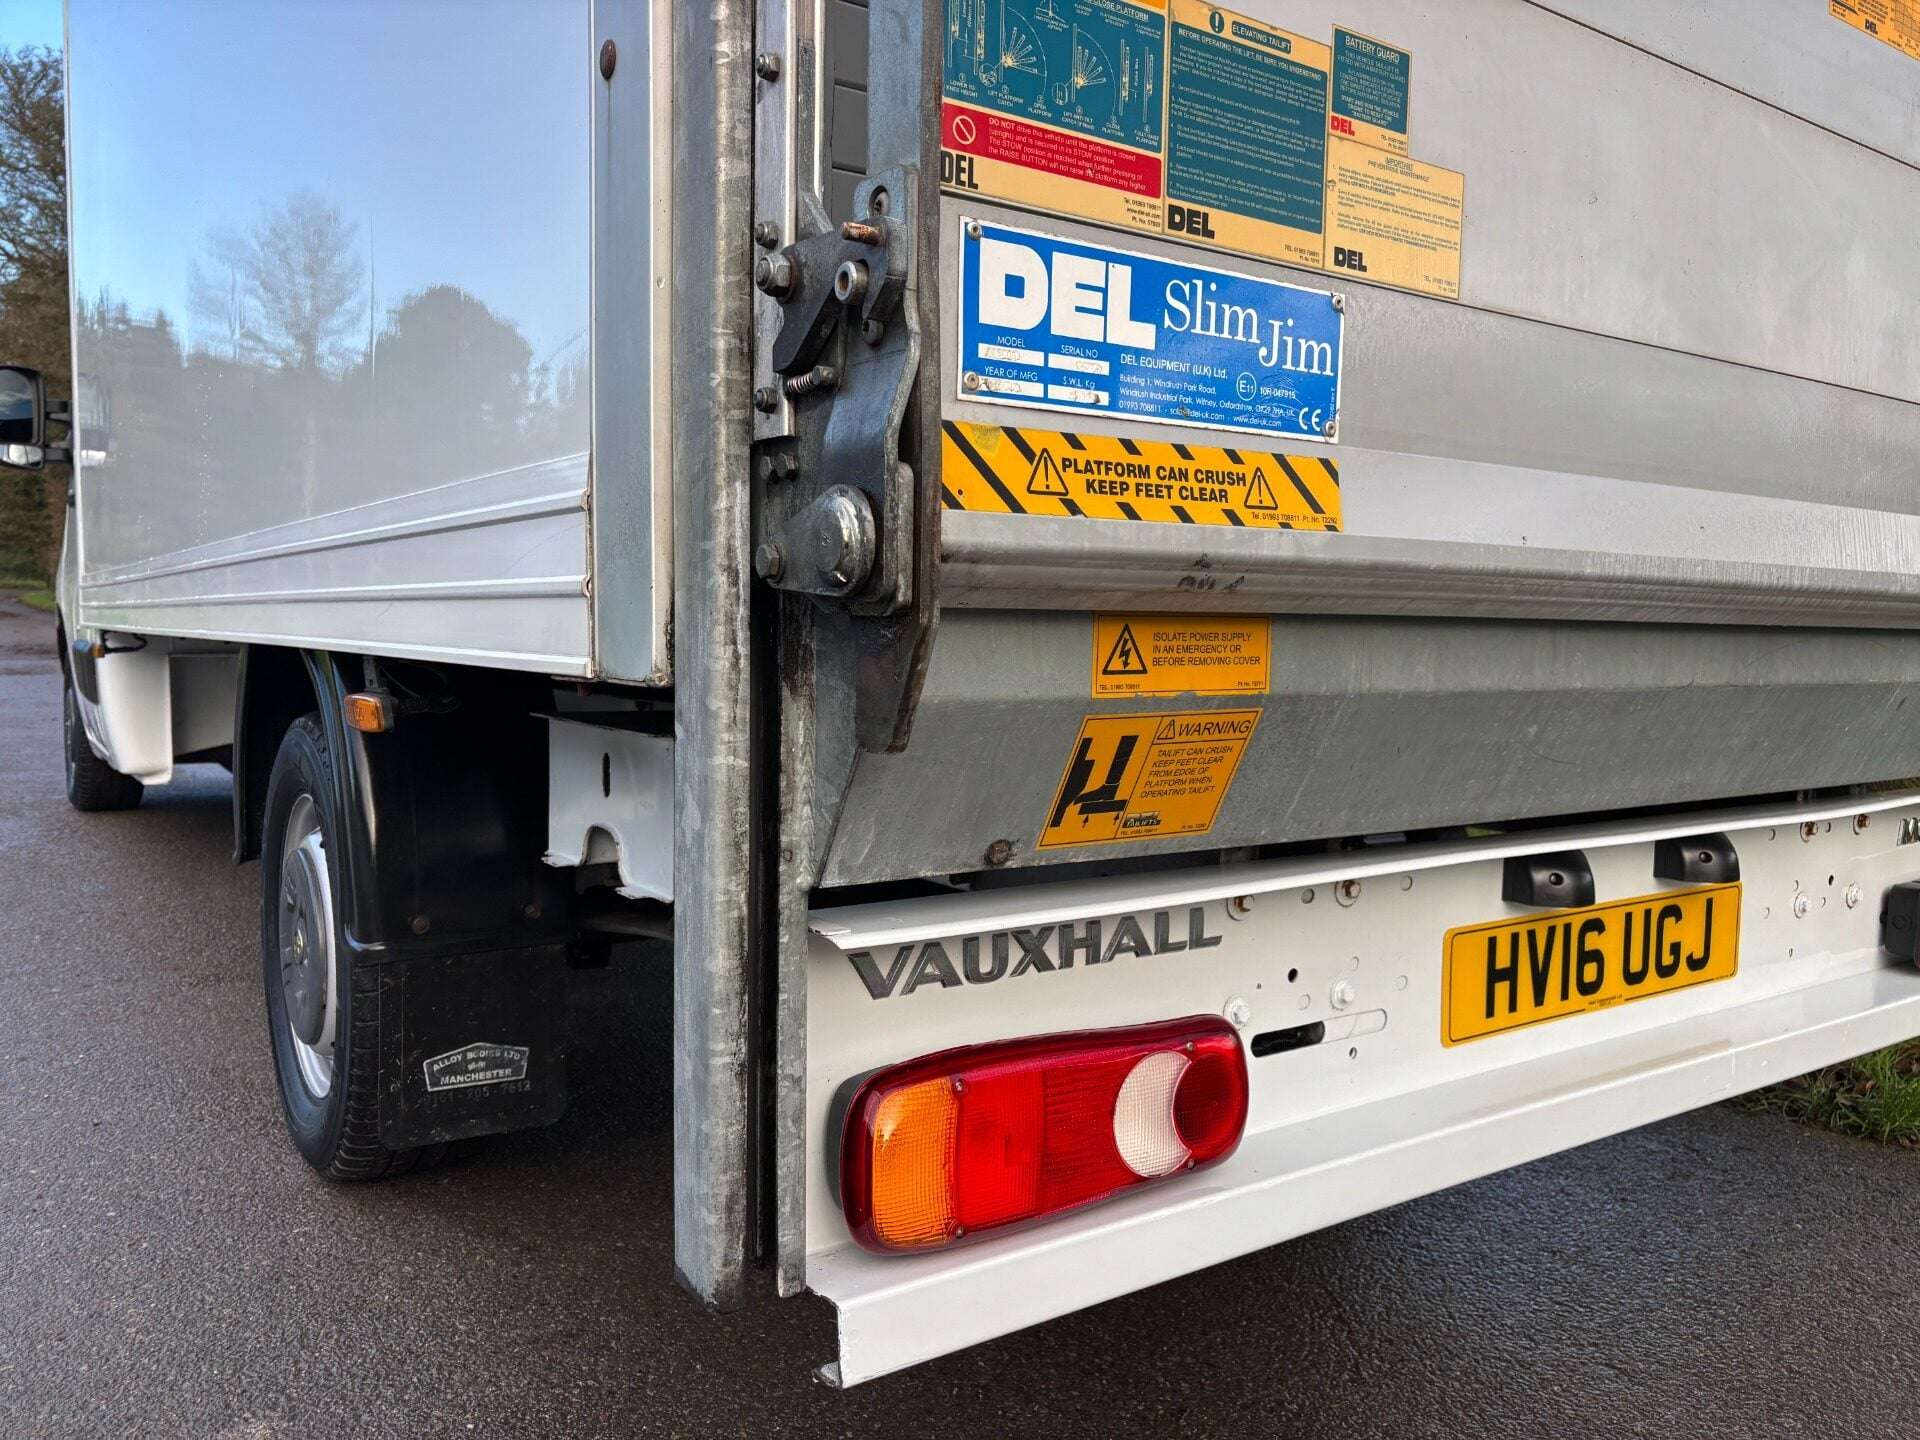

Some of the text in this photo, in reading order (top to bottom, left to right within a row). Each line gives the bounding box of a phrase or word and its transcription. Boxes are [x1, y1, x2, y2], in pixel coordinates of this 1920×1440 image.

[1116, 4, 1149, 21] PLATFORM
[1232, 24, 1268, 43] ELEVATING
[1178, 27, 1200, 40] BEFORE
[1201, 35, 1233, 51] OPERATING
[1264, 56, 1278, 66] SURE
[1278, 62, 1289, 70] YOU
[1289, 64, 1322, 81] UNDERSTAND
[1345, 35, 1400, 64] BATTERY GUARD
[950, 80, 968, 89] LOWER
[999, 92, 1024, 104] PLATFORM
[1034, 102, 1046, 110] OPEN
[1028, 107, 1052, 118] PLATFORM
[1102, 127, 1125, 137] PLATFORM
[1331, 115, 1355, 136] DEL
[988, 117, 1000, 127] DO
[1001, 120, 1015, 130] NOT
[1016, 125, 1031, 135] drive
[1032, 128, 1043, 138] this
[1044, 133, 1065, 143] vehicle
[1065, 137, 1077, 145] until
[1078, 141, 1088, 149] the
[1088, 143, 1112, 155] platform
[1118, 152, 1136, 162] closed
[1015, 134, 1027, 143] and
[1034, 139, 1058, 150] secured
[1073, 148, 1092, 159] STOW
[1136, 136, 1158, 146] PLATFORM
[989, 136, 1001, 145] The
[1002, 140, 1023, 151] STOW
[1023, 146, 1046, 158] position
[1053, 153, 1077, 165] reached
[1077, 160, 1093, 168] when
[1094, 162, 1112, 174] further
[1112, 168, 1136, 181] pressing
[999, 148, 1020, 160] RAISE
[1021, 153, 1048, 166] BUTTON
[1069, 167, 1084, 176] raise
[1095, 173, 1117, 184] platform
[1118, 179, 1128, 187] any
[941, 151, 979, 190] DEL
[1168, 204, 1215, 239] DEL
[1334, 246, 1367, 272] DEL
[978, 236, 1334, 377] DEL Slim Jim
[997, 335, 1099, 358] MODEL SERIAL NO
[1120, 353, 1139, 366] DEL
[1140, 356, 1191, 373] EQUIPMENT
[1213, 368, 1228, 380] Ltd.
[984, 366, 1005, 377] YEAR
[1006, 368, 1018, 379] OF
[1019, 370, 1038, 381] MFG
[1085, 380, 1096, 390] Kg
[1119, 374, 1145, 386] Building
[1154, 378, 1183, 389] Windrush
[1183, 382, 1197, 392] Park
[1119, 386, 1149, 398] Windrush
[1149, 390, 1178, 402] Industrial
[1255, 404, 1271, 414] OX29
[1286, 408, 1296, 417] UK
[1118, 400, 1138, 409] 01993
[1139, 402, 1161, 413] 708811
[1233, 415, 1282, 428] www.del-uk.com
[1061, 457, 1247, 487] PLATFORM CAN CRUSH
[1086, 478, 1229, 503] KEEP FEET CLEAR
[1153, 632, 1251, 642] ISOLATE POWER SUPPLY
[1153, 645, 1242, 654] IN AN EMERGENCY OR
[1152, 656, 1261, 666] BEFORE REMOVING COVER
[1178, 719, 1251, 737] WARNING
[1152, 756, 1225, 768] KEEP FEET CLEAR
[1158, 745, 1234, 758] TAILIFT CAN CRUSH
[1144, 776, 1213, 789] PLATFORM WHEN
[1149, 766, 1210, 778] FROM EDGE OF
[1140, 787, 1185, 799] OPERATING
[846, 907, 1223, 1000] VAUXHALL
[1485, 897, 1714, 1019] HV16 UGJ
[432, 1053, 463, 1072] ALLOY
[466, 1048, 501, 1059] BODIES
[504, 1050, 521, 1060] LTD
[440, 1068, 512, 1085] MANCHESTER
